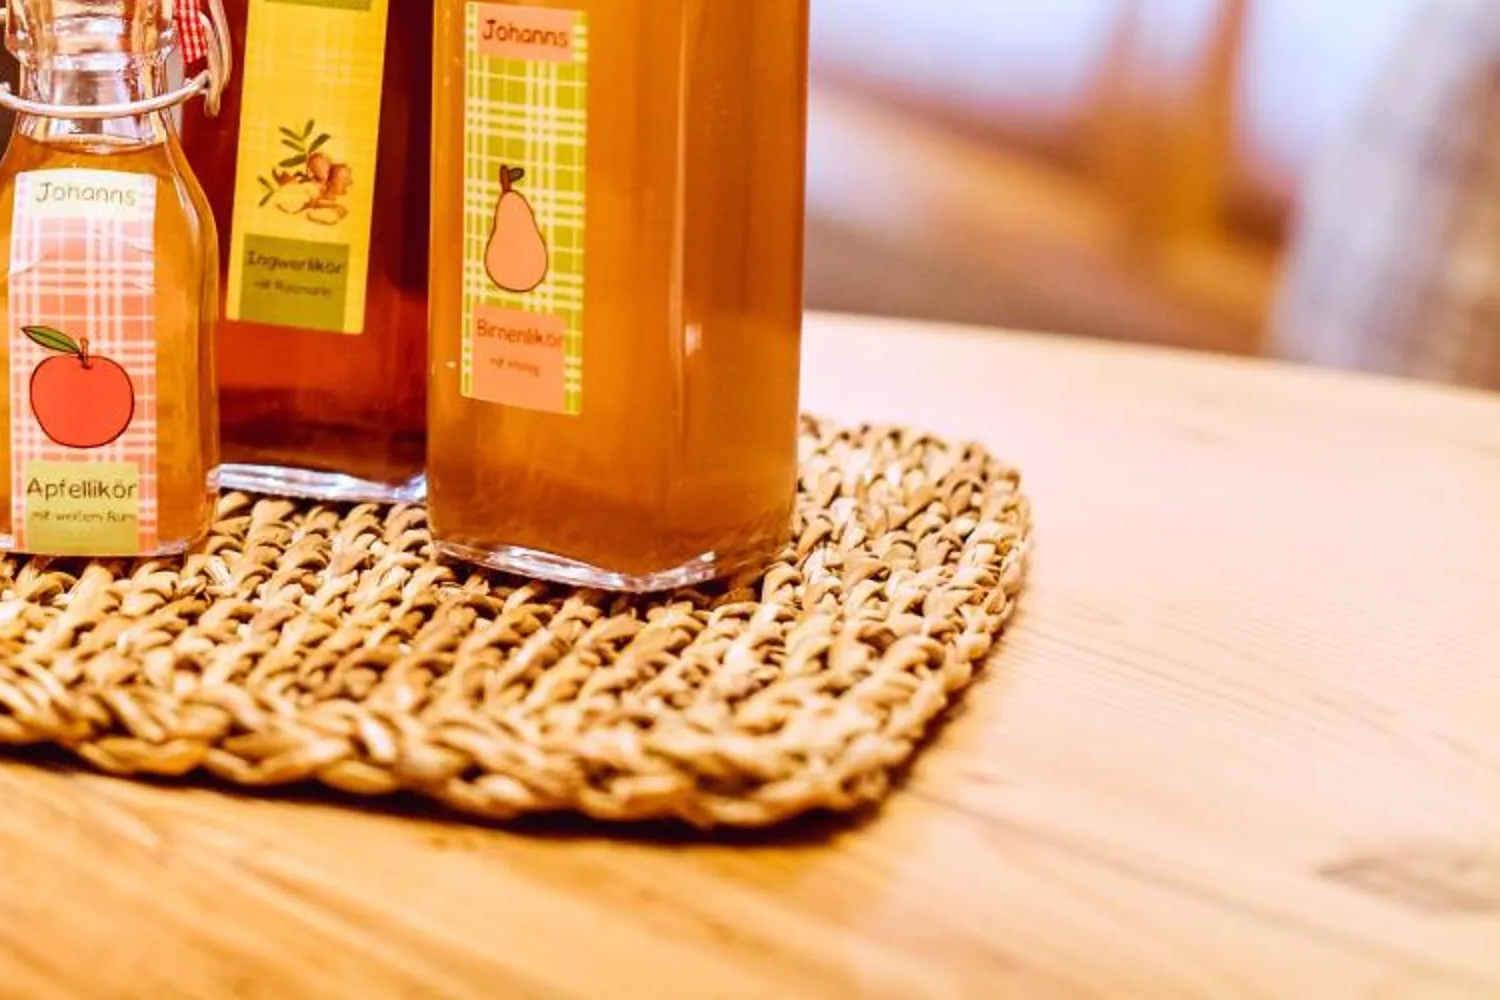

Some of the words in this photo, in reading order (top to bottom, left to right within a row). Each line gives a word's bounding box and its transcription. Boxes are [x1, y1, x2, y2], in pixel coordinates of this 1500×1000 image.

[482, 18, 569, 49] Johanns
[34, 180, 138, 207] Johanns
[25, 476, 139, 501] Apfellikör
